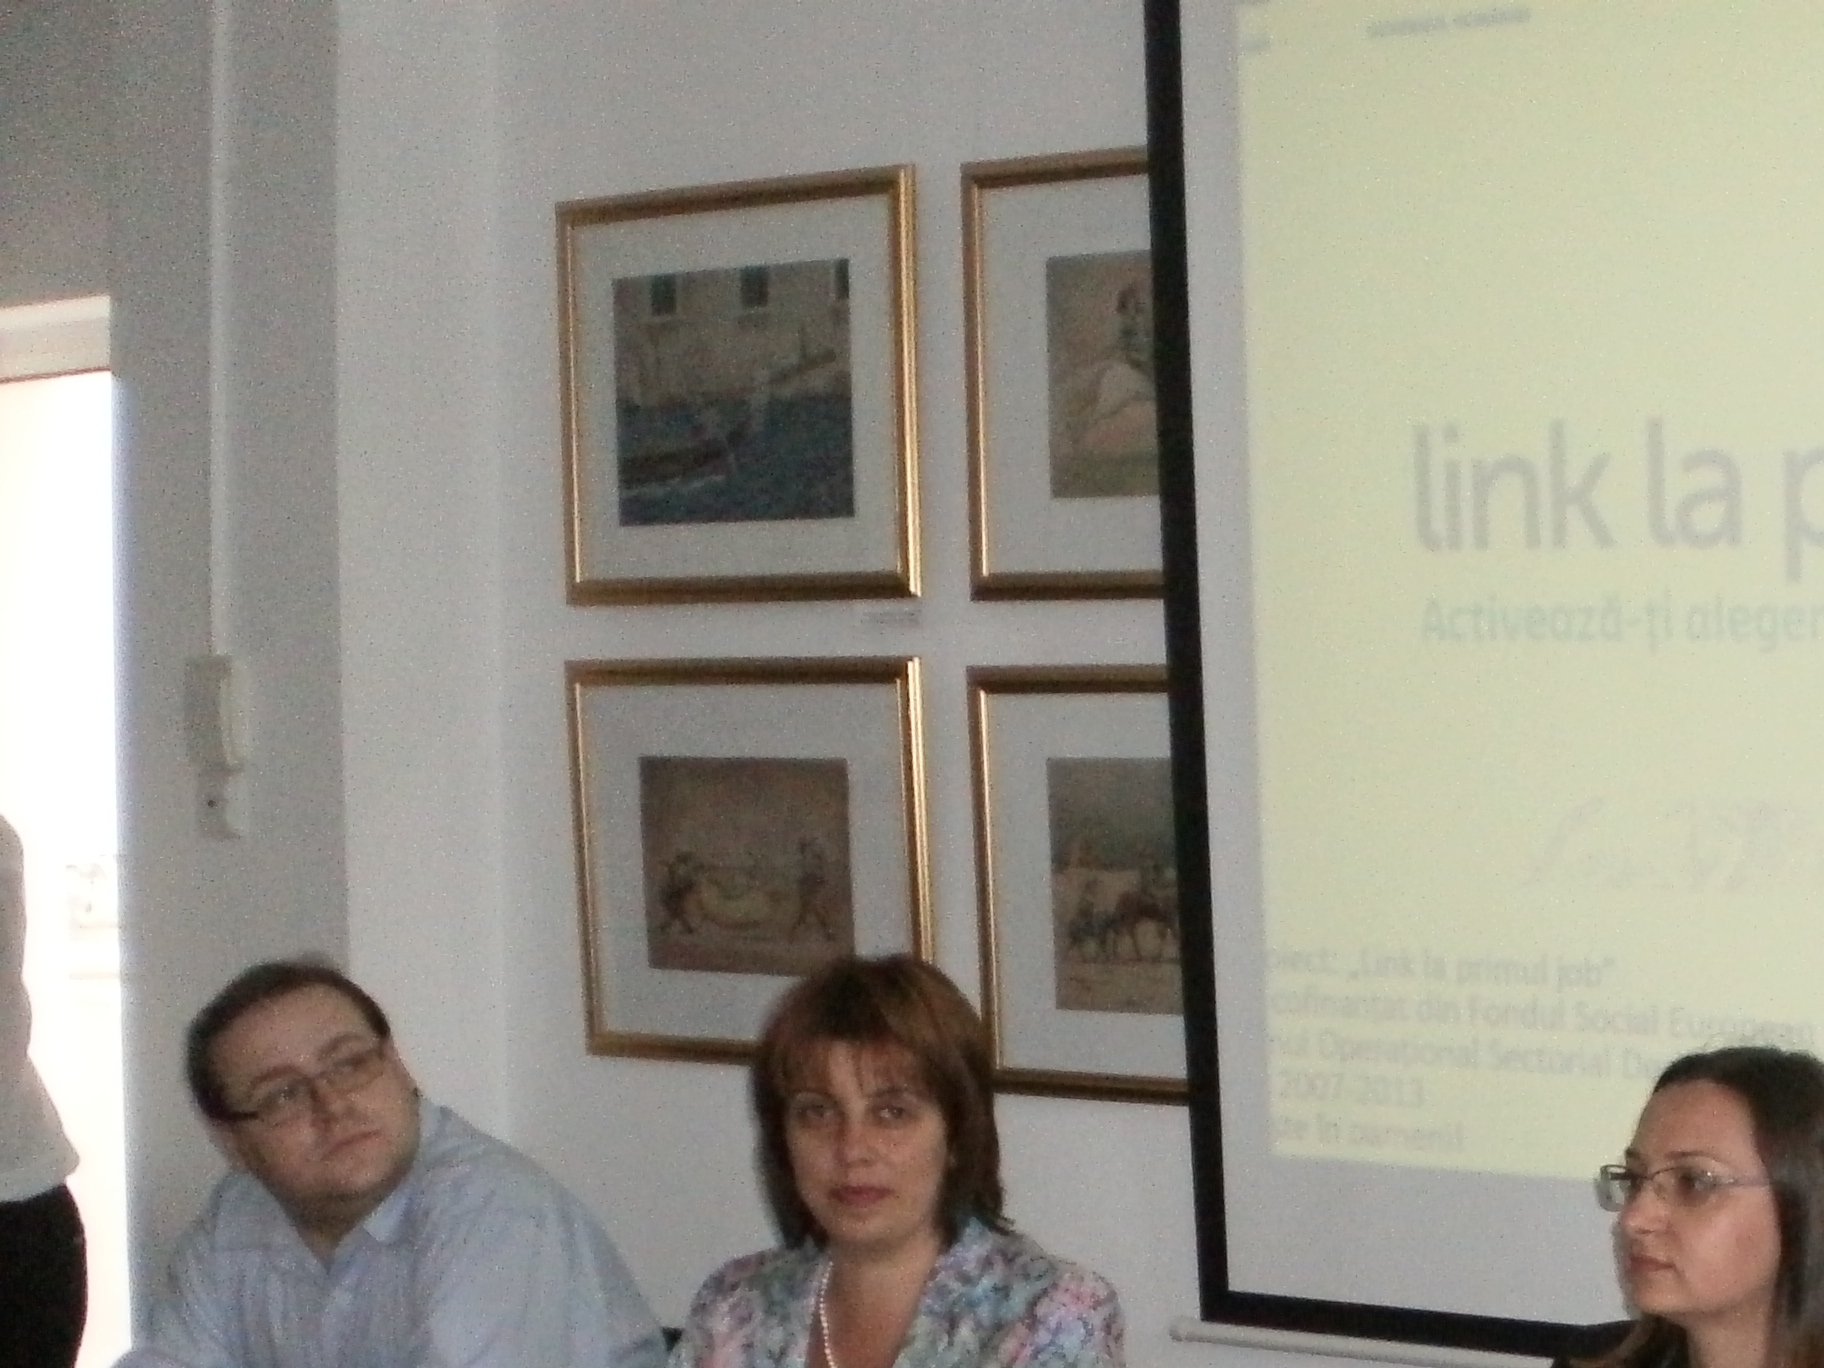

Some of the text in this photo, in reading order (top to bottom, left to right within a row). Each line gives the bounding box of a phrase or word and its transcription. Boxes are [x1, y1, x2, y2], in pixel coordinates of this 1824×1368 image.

[1411, 417, 1619, 554] link
[1643, 413, 1747, 551] la
[1455, 953, 1549, 988] primul
[1416, 989, 1461, 1024] din
[1466, 994, 1567, 1031] Fondul
[1574, 1001, 1658, 1036] Social
[1488, 1036, 1611, 1078] Sectorial
